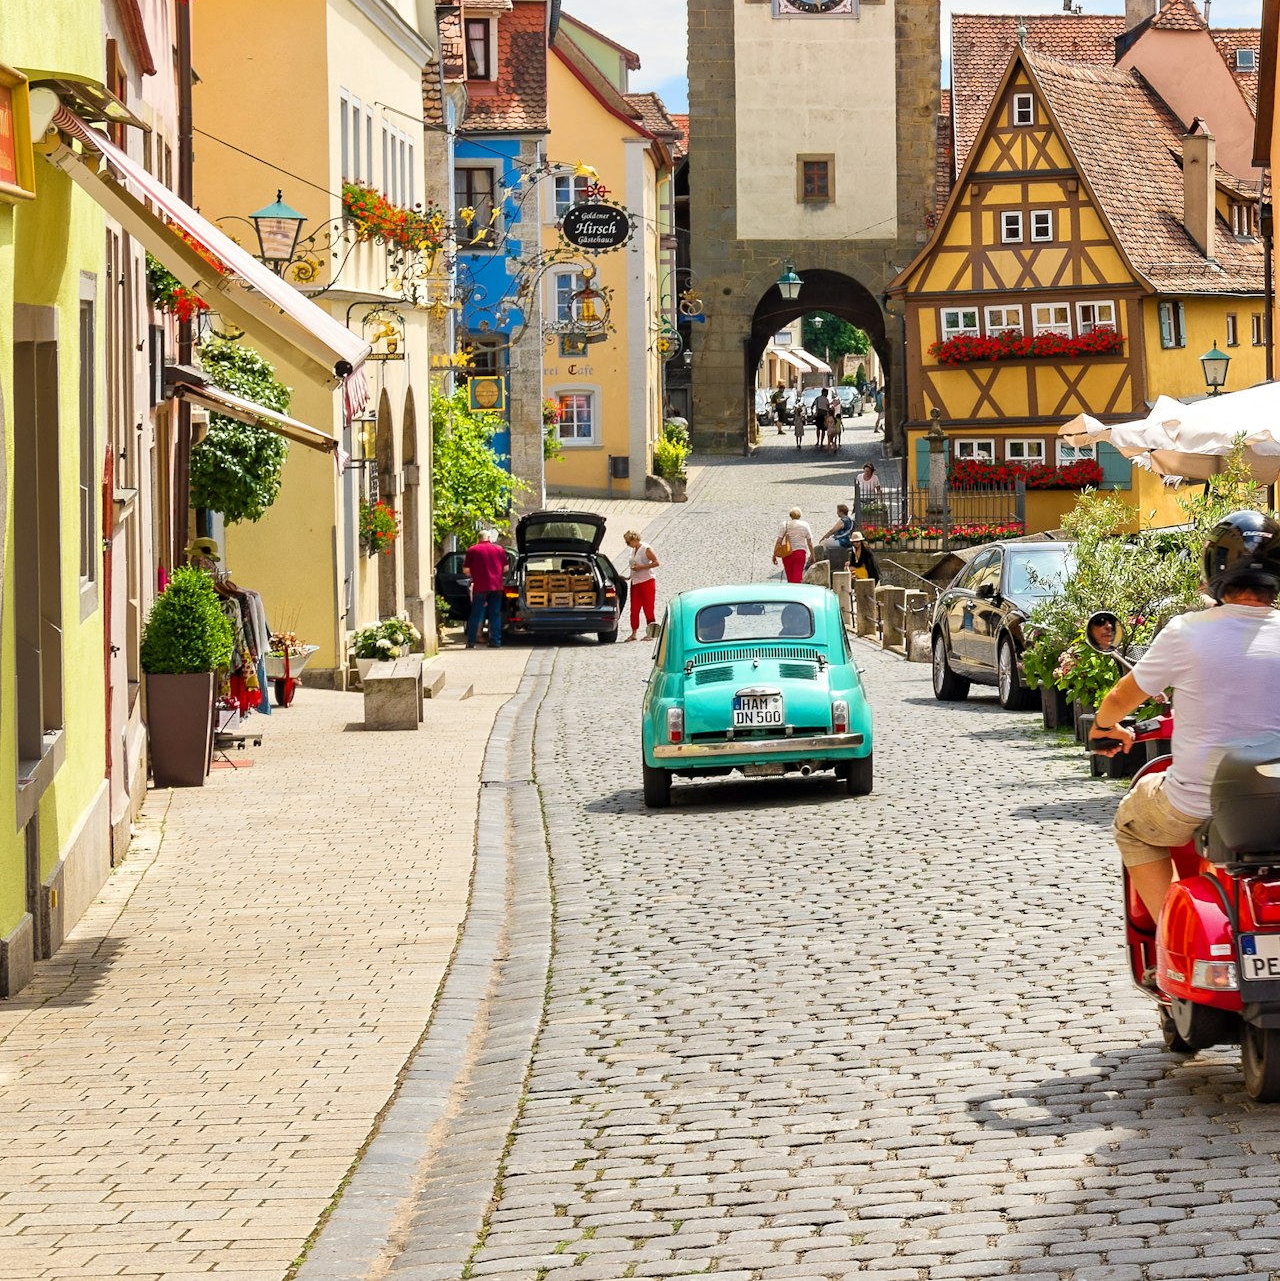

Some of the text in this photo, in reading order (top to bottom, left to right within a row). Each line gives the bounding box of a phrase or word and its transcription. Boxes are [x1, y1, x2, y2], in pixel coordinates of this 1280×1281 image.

[581, 211, 610, 221] Goldener
[575, 221, 617, 234] Hirsch
[578, 236, 614, 244] Gästehaus
[742, 698, 768, 710] HAM
[736, 711, 781, 724] DN 500
